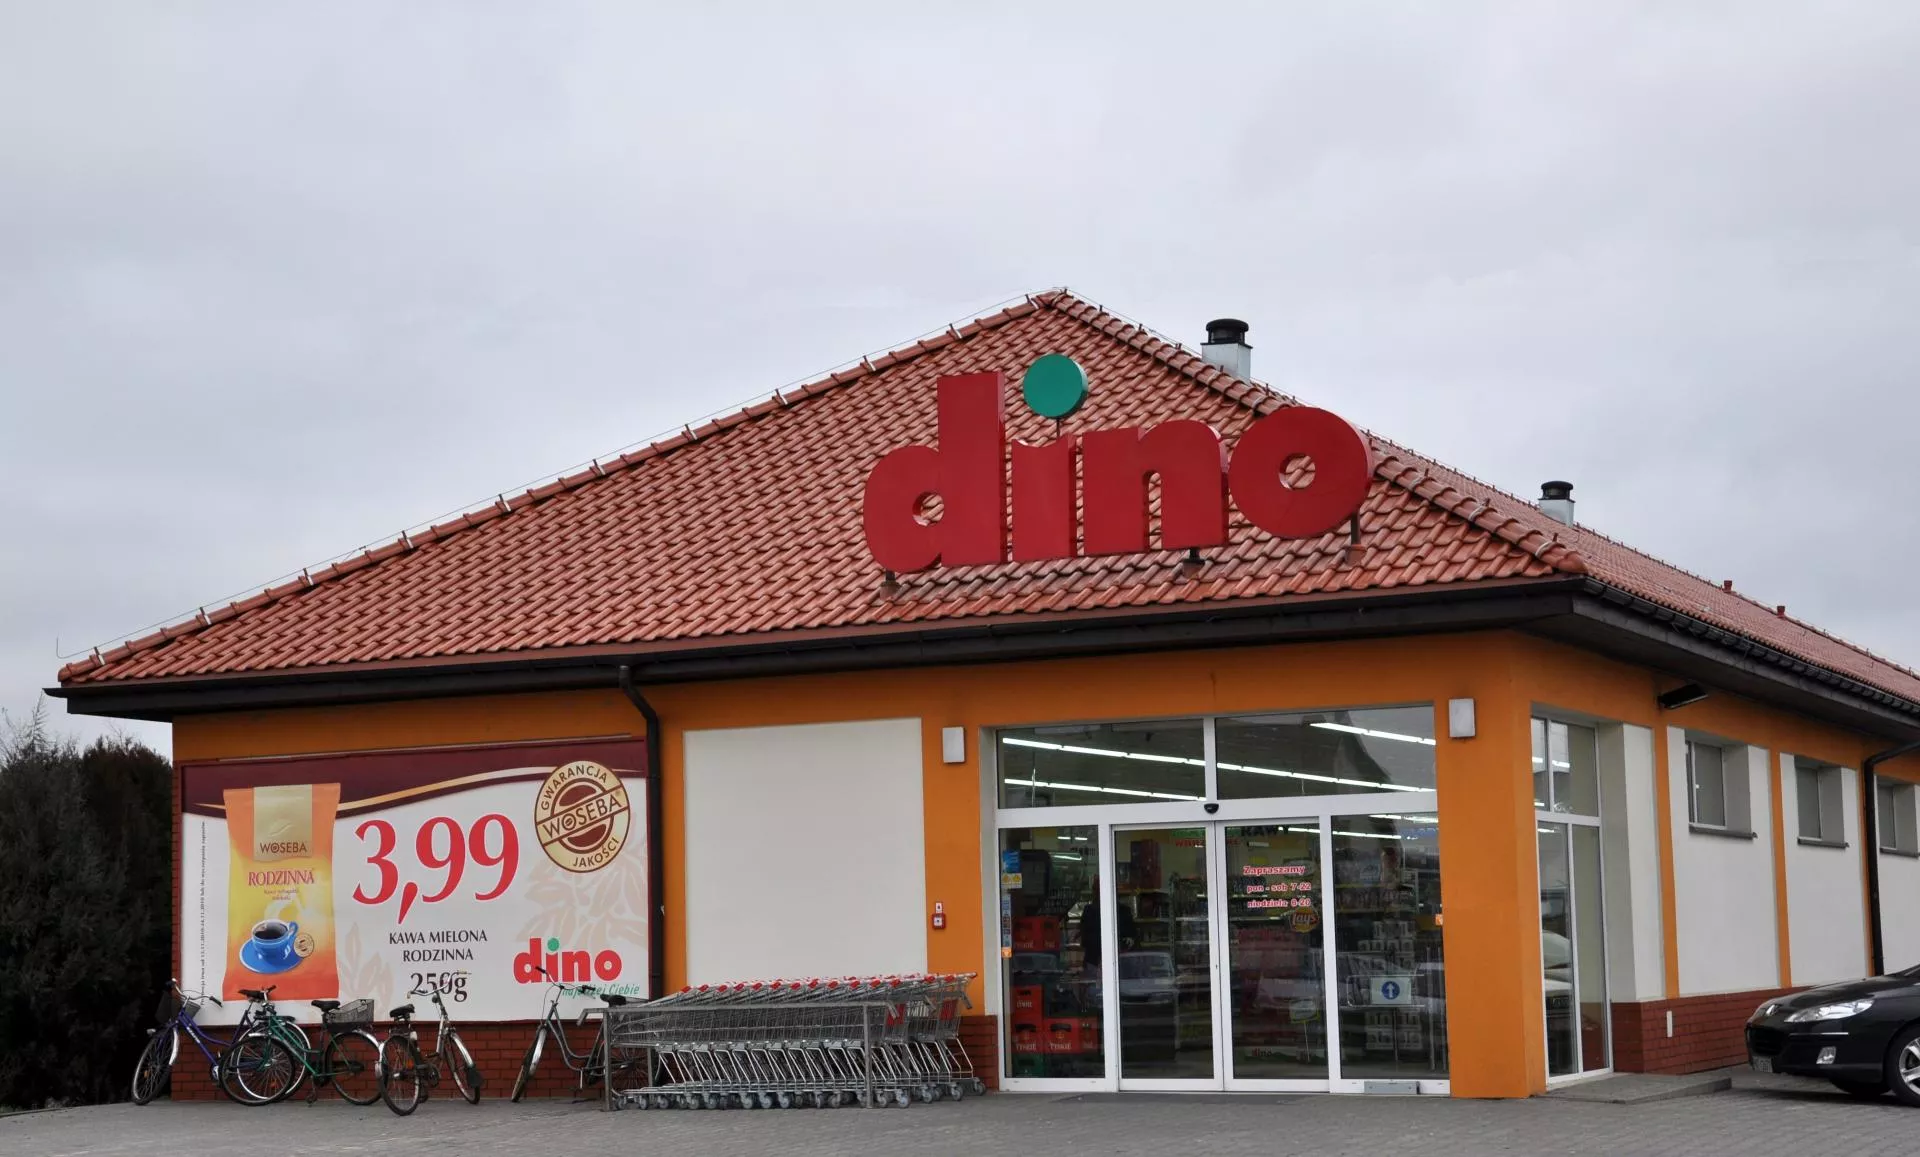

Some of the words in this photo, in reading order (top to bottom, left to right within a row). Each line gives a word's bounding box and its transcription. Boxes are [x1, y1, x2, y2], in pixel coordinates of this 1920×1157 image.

[863, 353, 1374, 573] dino
[541, 764, 607, 811] GWARANCJA
[542, 794, 622, 839] WOSEBA
[260, 842, 308, 854] WOSEBA
[573, 837, 619, 868] JAKOŚCI
[248, 870, 314, 886] RODZINNA
[352, 814, 519, 924] 3,99
[1243, 866, 1306, 876] Zapraszamy
[389, 931, 425, 944] KAWA
[429, 929, 488, 943] MIELONA
[403, 948, 474, 962] RODZINNA
[513, 937, 622, 985] dino
[410, 972, 468, 1003] 250g
[609, 984, 640, 995] Ciebie
